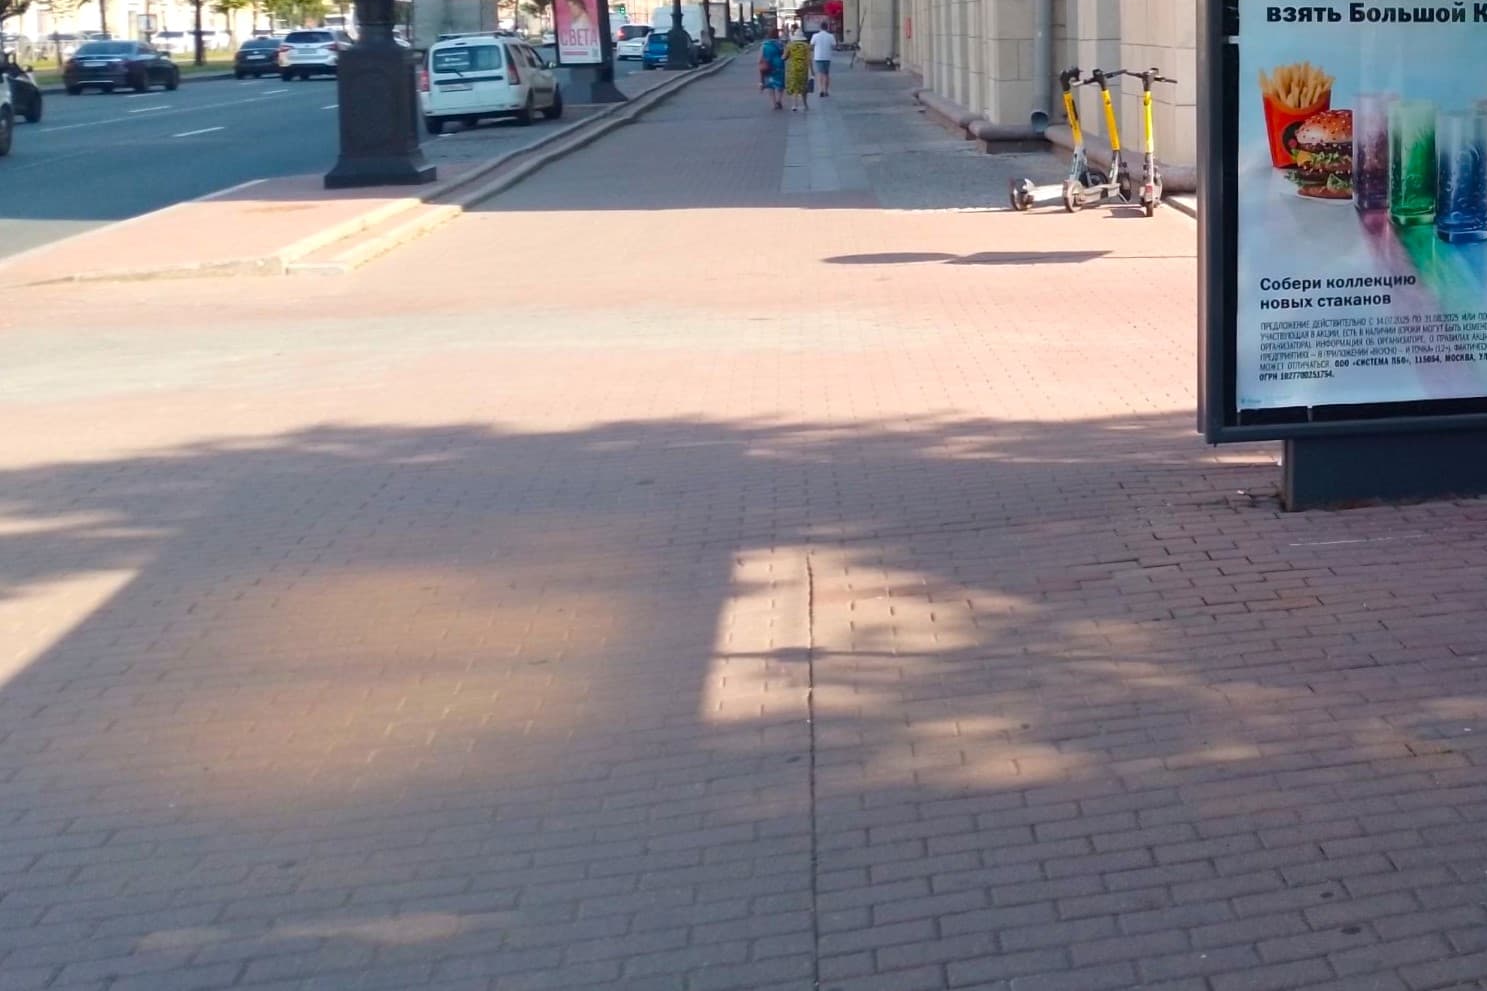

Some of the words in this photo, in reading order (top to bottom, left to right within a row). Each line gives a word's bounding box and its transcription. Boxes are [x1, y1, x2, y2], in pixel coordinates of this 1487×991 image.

[1266, 6, 1342, 22] взять
[1349, 1, 1466, 23] Большой
[560, 29, 598, 46] СВЕТА
[1259, 277, 1321, 292] Собери
[1326, 274, 1416, 289] коллекцию
[1260, 297, 1313, 310] новых
[1317, 294, 1391, 307] стаканов
[1335, 359, 1349, 368] ООО
[1259, 373, 1278, 381] ОГРН
